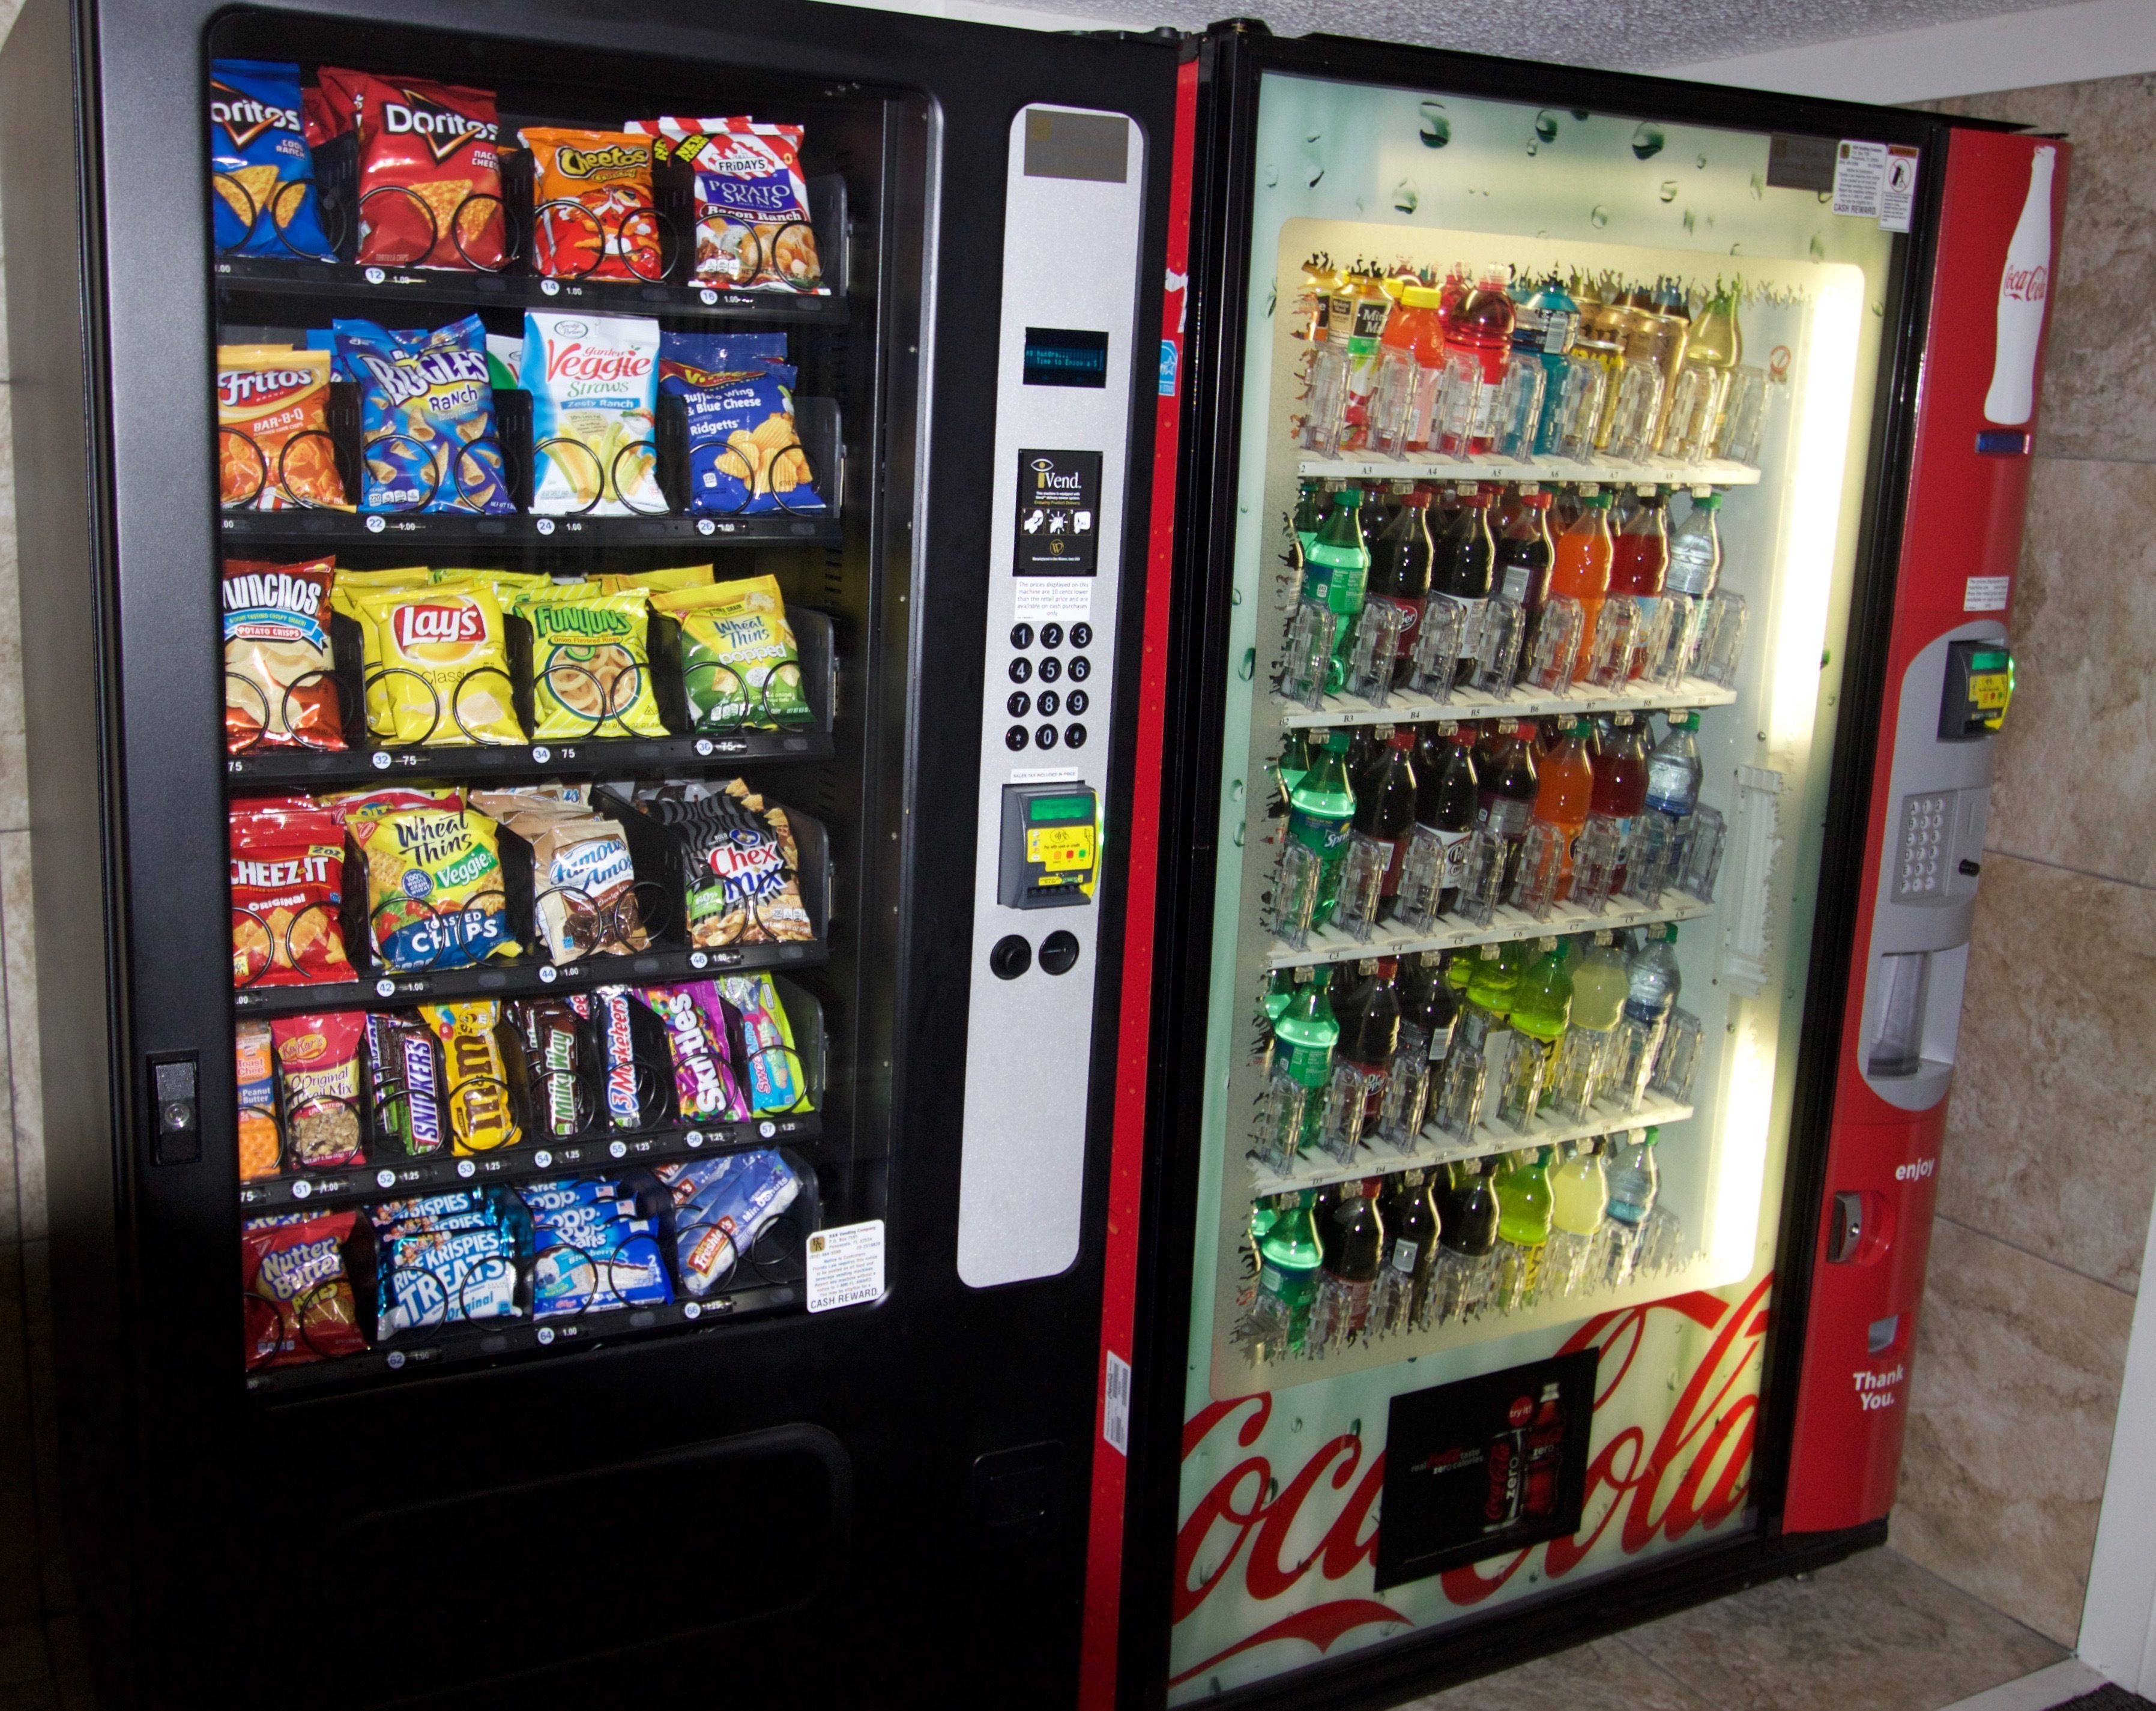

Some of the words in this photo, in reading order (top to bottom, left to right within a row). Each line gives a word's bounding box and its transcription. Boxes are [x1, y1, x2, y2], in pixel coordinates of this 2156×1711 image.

[212, 99, 300, 130] oritos
[385, 103, 498, 140] Doritos
[558, 146, 648, 171] Cheetos
[709, 180, 790, 196] POTATO
[723, 191, 782, 208] SKINS
[708, 206, 753, 219] Bacon
[756, 212, 802, 221] Ranch
[1834, 203, 1849, 212] CASH
[1851, 205, 1876, 215] REWARD
[369, 270, 381, 279] 12
[545, 282, 557, 292] 14
[582, 346, 624, 357] garden
[547, 339, 652, 382] Veggie
[221, 369, 312, 405] Fritos
[567, 381, 629, 397] Straws
[724, 388, 754, 397] Wing
[567, 400, 596, 408] Zesty
[600, 399, 634, 408] Ranch
[688, 407, 695, 416] &
[696, 402, 720, 413] Blue
[723, 399, 761, 409] Cheese
[253, 408, 304, 432] BAR-B-Q
[690, 420, 738, 435] Ridgetts
[369, 519, 382, 528] 22
[399, 523, 415, 531] 1.00
[541, 522, 552, 531] 24
[238, 626, 270, 635] POTATO
[273, 628, 299, 637] CRISPS
[402, 605, 479, 646] Lay's
[713, 616, 764, 634] Wheat
[720, 629, 770, 648] Thins
[1019, 629, 1026, 645] 1
[1049, 629, 1057, 643] 2
[1078, 628, 1087, 644] 3
[719, 642, 787, 665] popped
[421, 669, 475, 685] Classic
[1016, 663, 1025, 678] 4
[1046, 663, 1055, 678] 5
[1076, 662, 1084, 677] 6
[1017, 698, 1025, 712] 7
[1045, 696, 1053, 711] 8
[1073, 695, 1083, 711] 9
[375, 755, 388, 764] 32
[402, 755, 417, 765] 75
[536, 750, 548, 759] 34
[562, 750, 575, 758] 75
[228, 761, 243, 771] 75
[394, 812, 468, 848] Wheat
[400, 833, 473, 867] Thins
[550, 839, 627, 885] Famous
[711, 845, 778, 875] Chex
[437, 852, 489, 888] Veggie
[582, 855, 633, 892] Amos
[412, 919, 498, 952] CHIPS
[564, 967, 579, 976] 1.00
[379, 983, 391, 992] 42
[409, 983, 424, 992] 1.00
[298, 1038, 322, 1051] Kar's
[608, 995, 636, 1093] Musketeers
[669, 992, 726, 1113] Skittles
[302, 1067, 348, 1088] Original
[243, 1087, 271, 1096] Peanut
[329, 1082, 352, 1096] Mix
[406, 1039, 438, 1140] SNICKERS
[614, 1091, 633, 1111] 3
[762, 1126, 773, 1134] 57
[612, 1145, 624, 1153] 55
[486, 1162, 500, 1170] 1.25
[537, 1155, 549, 1163] 54
[380, 1174, 392, 1183] 52
[404, 1172, 419, 1180] 1.25
[1895, 1158, 1934, 1183] enjoy
[264, 1240, 337, 1278] Nutter
[426, 1232, 499, 1269] KRISPIES
[275, 1255, 342, 1299] Butter
[398, 1251, 504, 1323] TREATS
[811, 1295, 835, 1309] CASH
[838, 1288, 877, 1303] REWARD
[541, 1331, 552, 1341] 64
[563, 1327, 576, 1336] 1.00
[1853, 1365, 1903, 1391] Thank
[1861, 1392, 1894, 1411] You.
[1510, 1407, 1522, 1418] try
[1522, 1405, 1532, 1414] it!
[1533, 1443, 1554, 1455] zero
[1411, 1462, 1427, 1472] real
[1460, 1449, 1481, 1459] taste
[1433, 1464, 1452, 1474] zero
[1452, 1456, 1484, 1470] calories
[1506, 1456, 1519, 1500] zero
